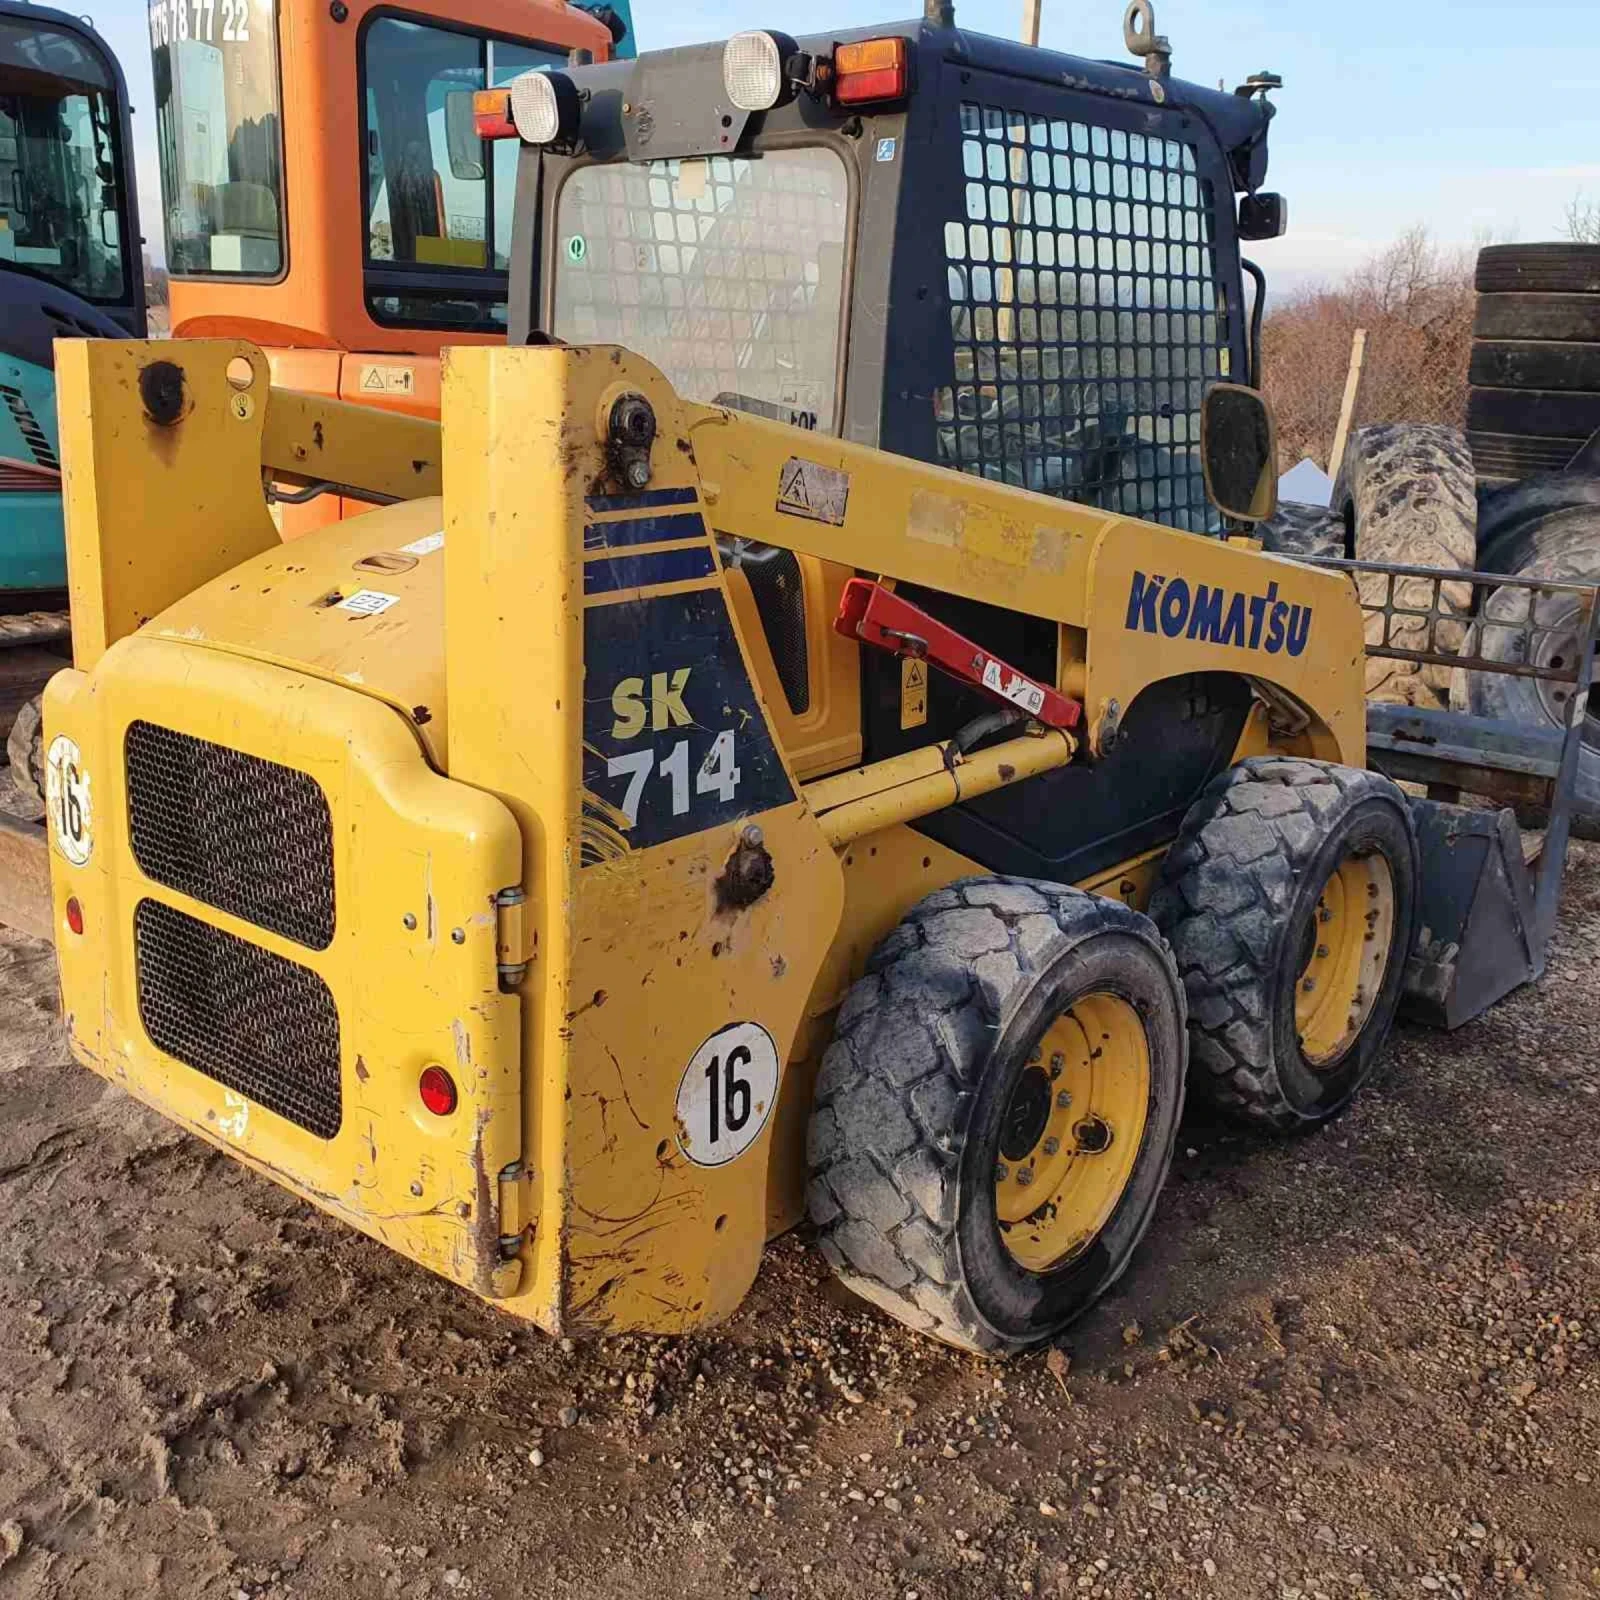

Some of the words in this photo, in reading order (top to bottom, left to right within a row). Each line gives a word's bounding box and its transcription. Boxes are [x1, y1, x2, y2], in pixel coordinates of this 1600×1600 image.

[169, 0, 189, 42] 78
[192, 0, 215, 41] 77
[221, 0, 250, 41] 22
[1125, 570, 1312, 657] KOMATSU
[611, 667, 694, 740] SK
[58, 757, 82, 842] 16
[607, 729, 741, 831] 714
[705, 1045, 751, 1144] 16
